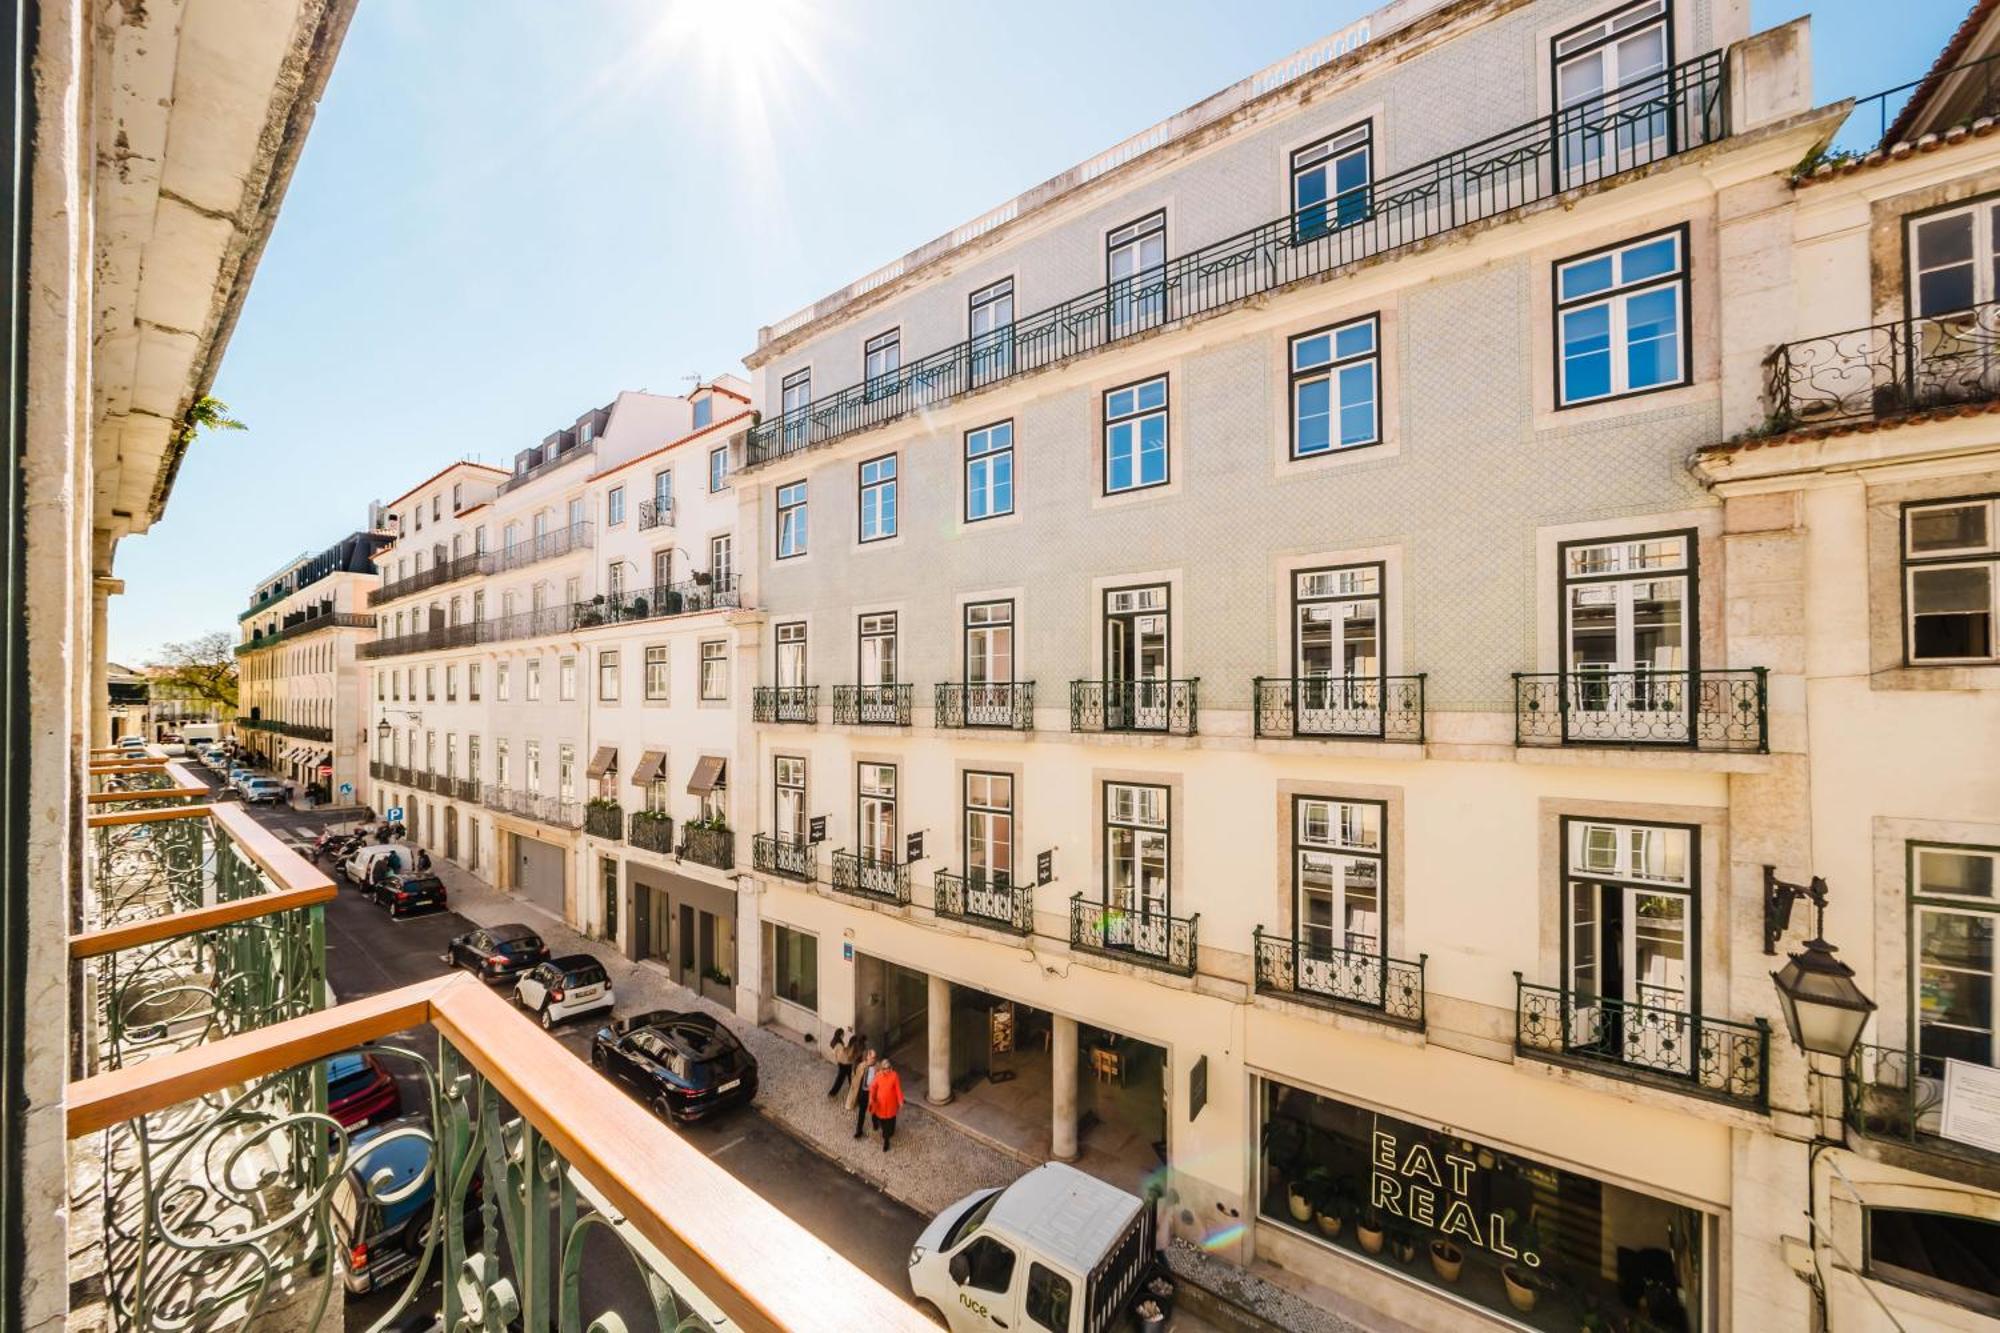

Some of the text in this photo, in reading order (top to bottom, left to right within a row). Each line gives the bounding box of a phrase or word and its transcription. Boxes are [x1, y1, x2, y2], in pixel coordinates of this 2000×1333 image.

[390, 809, 401, 820] P
[1373, 1131, 1476, 1196] EAT
[1372, 1171, 1540, 1267] REAL.
